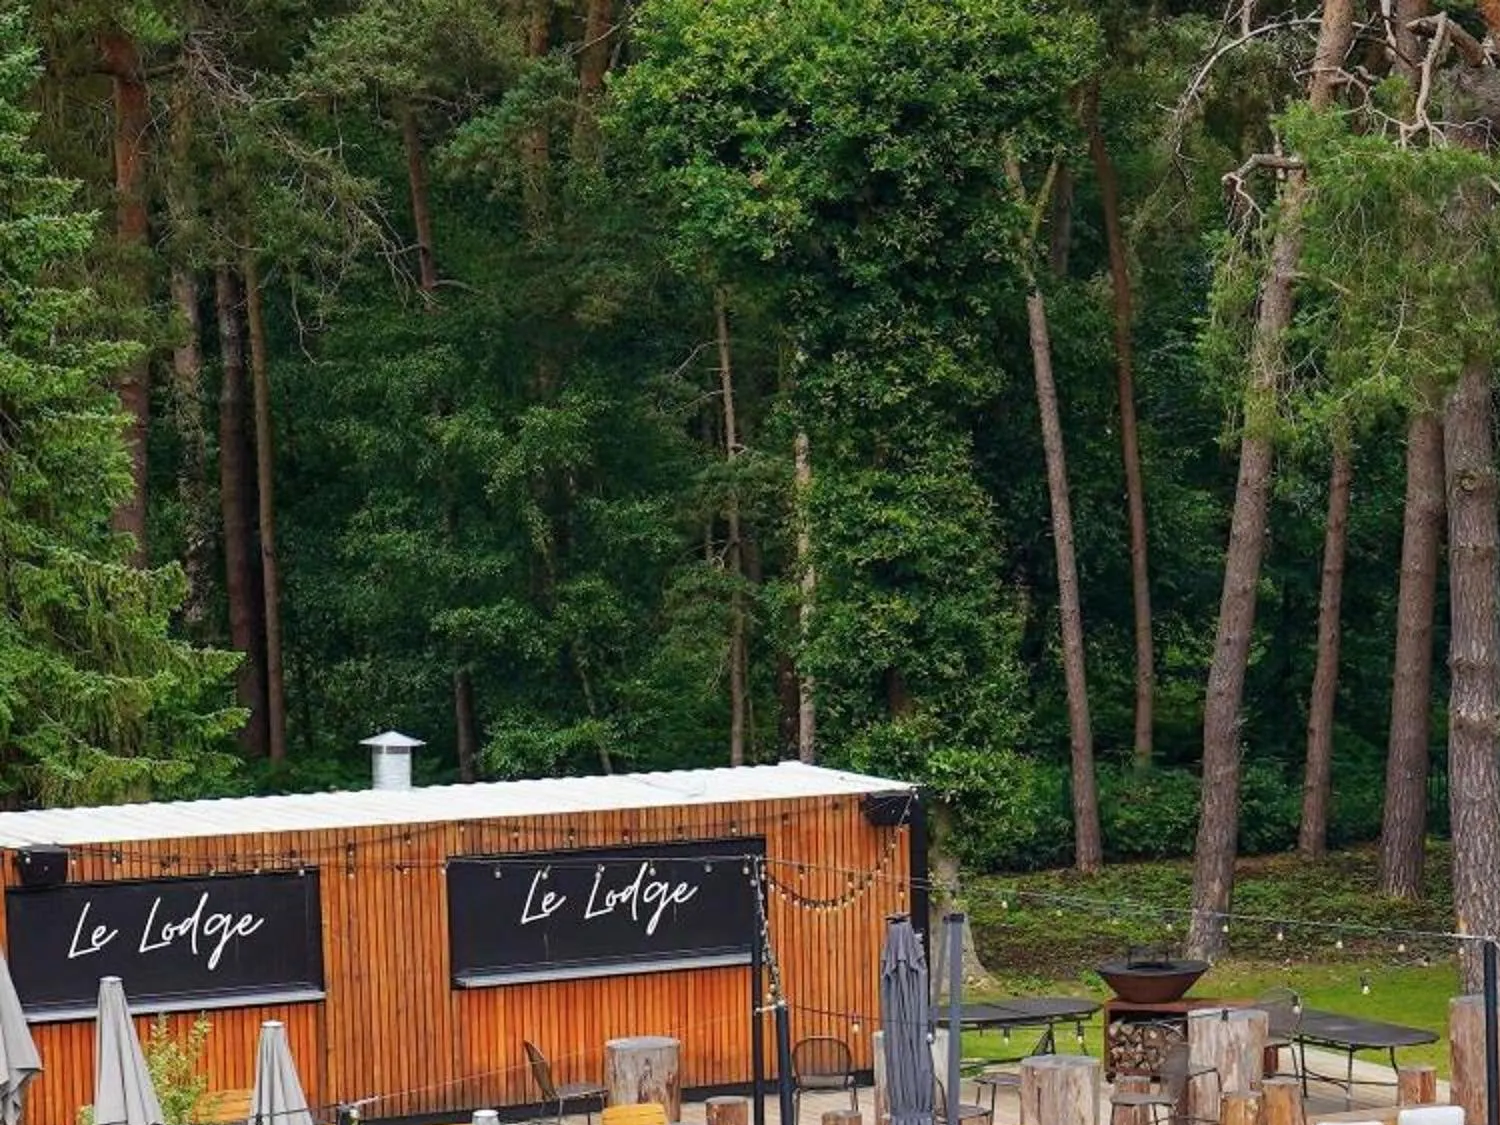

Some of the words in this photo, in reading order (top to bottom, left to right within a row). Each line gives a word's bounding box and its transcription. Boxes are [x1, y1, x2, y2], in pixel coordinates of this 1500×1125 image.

[67, 901, 118, 958] Le
[138, 892, 264, 969] Lodge
[520, 868, 565, 924] Le
[584, 862, 698, 935] Lodge
